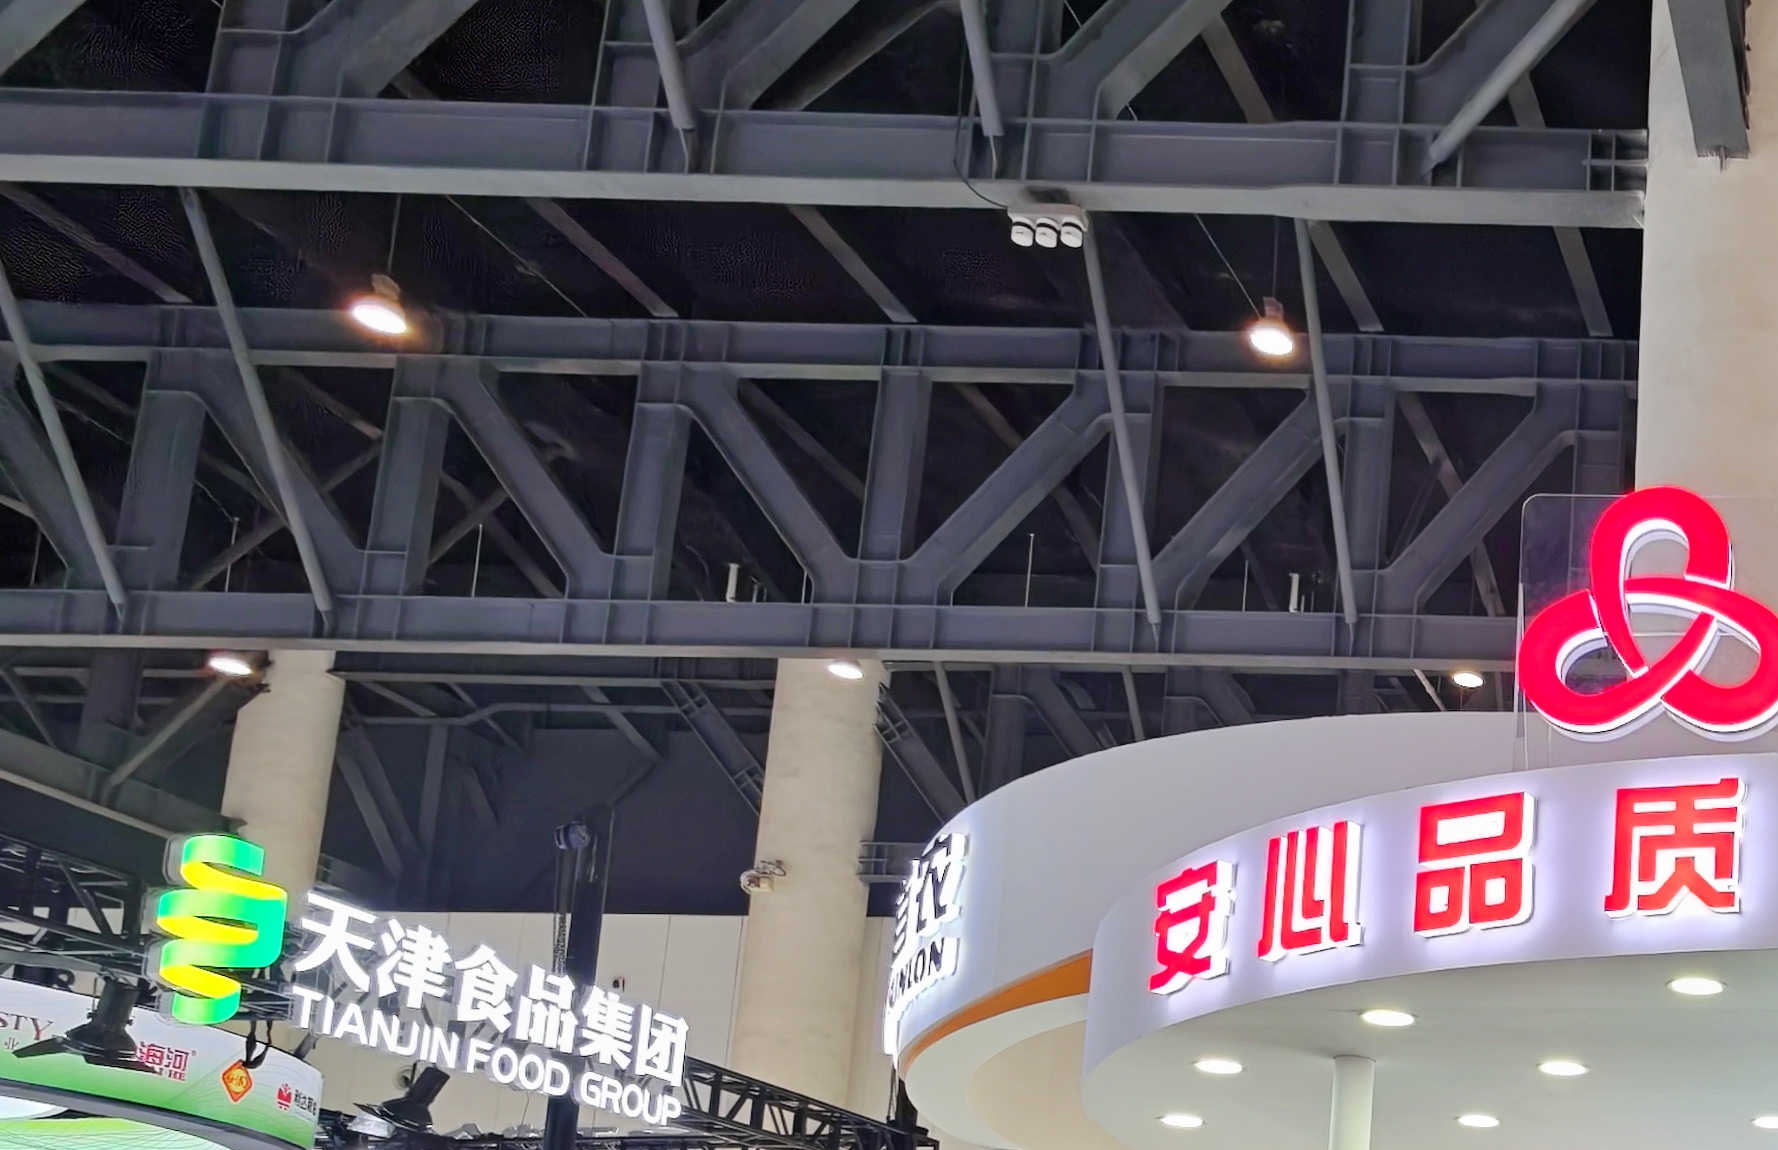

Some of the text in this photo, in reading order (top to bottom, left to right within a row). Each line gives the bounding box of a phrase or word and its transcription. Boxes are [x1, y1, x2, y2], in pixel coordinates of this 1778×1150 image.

[1147, 777, 1748, 996] 安心品质
[138, 1041, 190, 1072] 海河
[291, 984, 683, 1128] TIANJIN FOOD GROUP
[294, 890, 689, 1087] 天津食品集团
